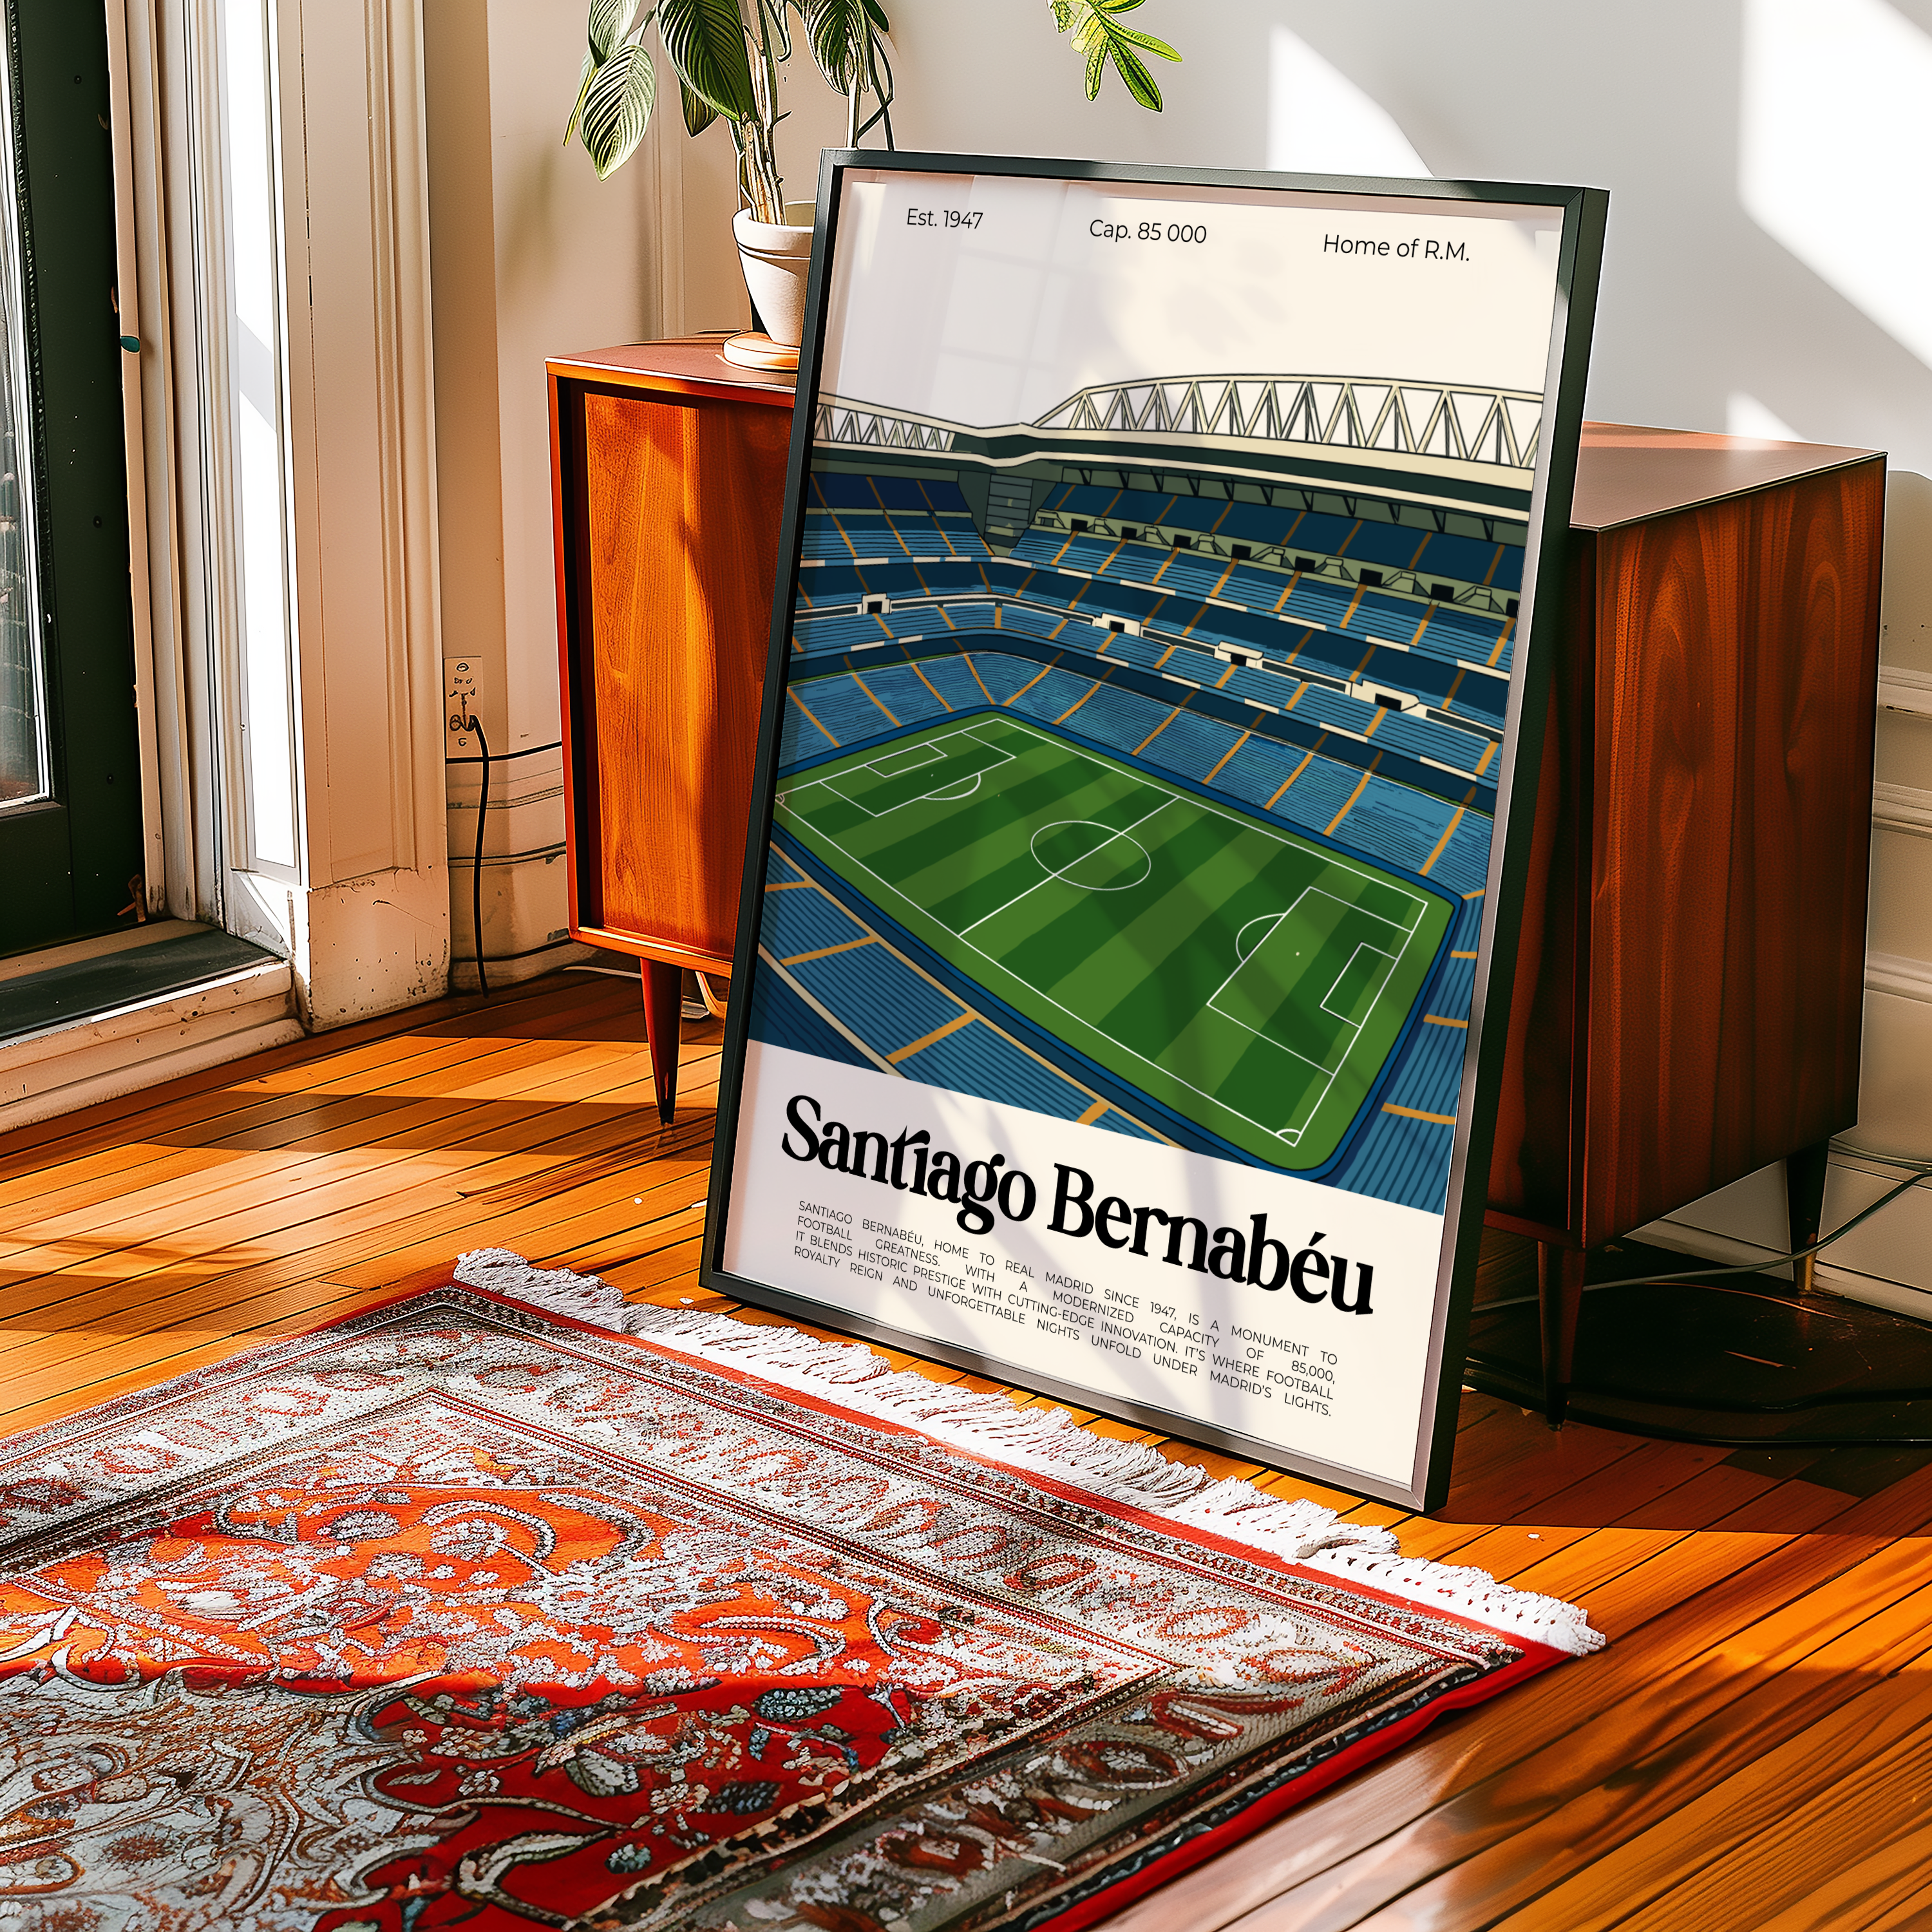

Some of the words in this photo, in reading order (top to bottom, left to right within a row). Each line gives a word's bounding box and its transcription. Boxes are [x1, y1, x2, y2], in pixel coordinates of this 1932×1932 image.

[907, 208, 938, 227] Est.
[943, 210, 983, 229] 1947
[1090, 219, 1132, 243] Cap.
[1137, 222, 1162, 241] 85
[1167, 223, 1207, 244] 000
[1323, 234, 1390, 256] Home
[1396, 238, 1421, 258] of
[1425, 240, 1470, 261] R.M.
[781, 1094, 1037, 1236] Santiago
[1046, 1162, 1374, 1316] Bernabéu
[799, 1200, 853, 1224] SANTIAGO
[862, 1218, 924, 1247] BERNABÉU,
[934, 1239, 969, 1259] HOME
[979, 1252, 995, 1266] TO
[1005, 1260, 1035, 1278] REAL
[1045, 1271, 1094, 1294] MADRID
[1104, 1289, 1140, 1309] SINCE
[1150, 1301, 1177, 1321] 1947,
[1188, 1312, 1200, 1326] IS
[1209, 1320, 1219, 1332] A
[1231, 1325, 1310, 1357] MONUMENT
[1320, 1350, 1338, 1365] TO
[794, 1245, 840, 1268] ROYALTY
[849, 1262, 883, 1282] REIGN
[892, 1276, 918, 1291] AND
[928, 1285, 1026, 1325] UNFORGETTABLE
[1037, 1318, 1080, 1341] NIGHTS
[1091, 1334, 1142, 1359] UNFOLD
[1153, 1352, 1198, 1377] UNDER
[1284, 1392, 1331, 1417] LIGHTS.
[796, 1230, 806, 1242] IT
[810, 1235, 853, 1256] BLENDS
[858, 1249, 908, 1273] HISTORIC
[913, 1265, 967, 1291] PRESTIGE
[972, 1282, 1002, 1301] WITH
[1007, 1294, 1095, 1329] CUTTING-EDGE
[1101, 1320, 1178, 1354] INNOVATION.
[1212, 1353, 1260, 1378] WHERE
[1266, 1370, 1334, 1400] FOOTBALL
[797, 1215, 853, 1241] FOOTBALL
[875, 1238, 940, 1267] GREATNESS.
[965, 1264, 995, 1283] WITH
[1019, 1281, 1028, 1293] A
[1052, 1290, 1134, 1323] MODERNIZED
[1159, 1321, 1220, 1348] CAPACITY
[1246, 1347, 1265, 1361] OF
[1291, 1359, 1335, 1385] 85,000,
